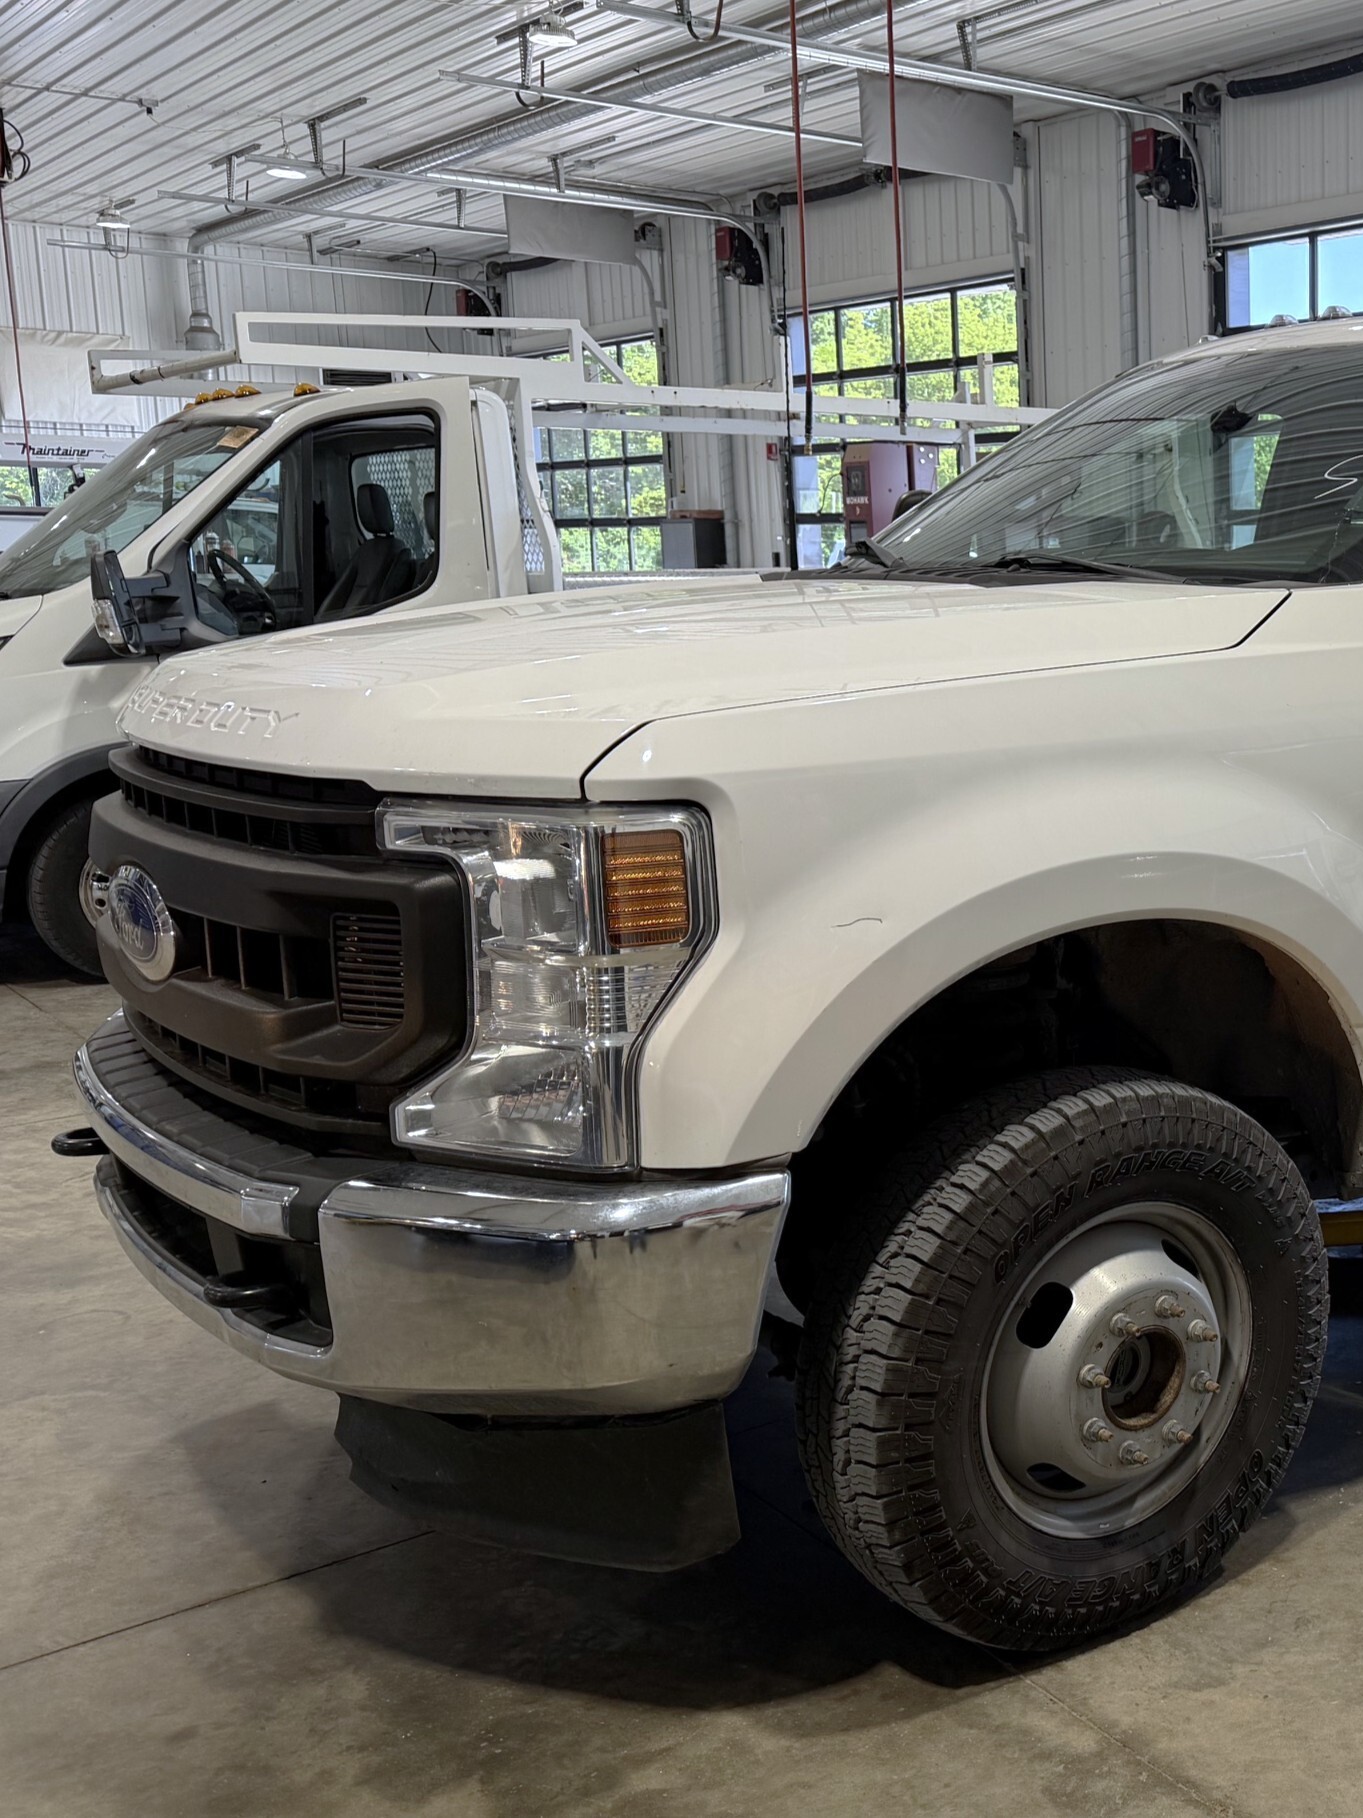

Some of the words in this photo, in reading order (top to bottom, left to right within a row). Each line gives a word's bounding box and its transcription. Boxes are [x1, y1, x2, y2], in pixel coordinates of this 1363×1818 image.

[16, 442, 94, 458] Maintainer
[846, 495, 869, 505] MOHAWK
[132, 685, 197, 724] SUPER
[186, 701, 300, 738] DUTY
[991, 1181, 1076, 1285] OPEN
[1083, 1148, 1209, 1199] RANGE
[1198, 1158, 1257, 1193] A/T
[1197, 1447, 1270, 1554] OPEN
[1002, 1567, 1067, 1603] A/T
[1065, 1538, 1187, 1606] RANGE
